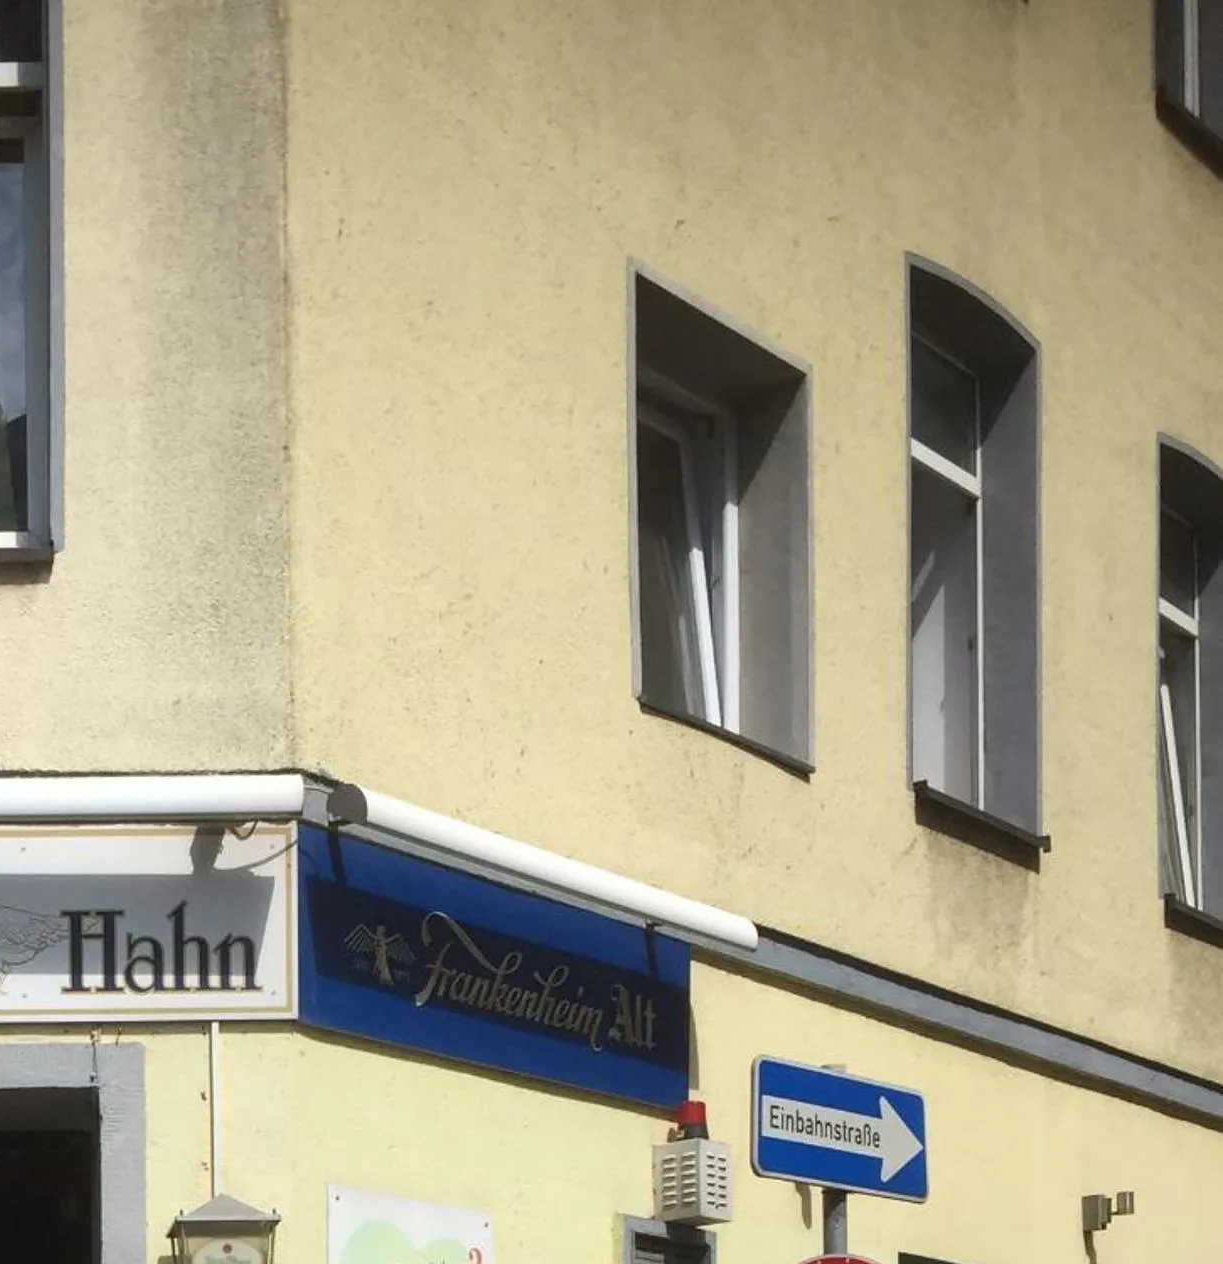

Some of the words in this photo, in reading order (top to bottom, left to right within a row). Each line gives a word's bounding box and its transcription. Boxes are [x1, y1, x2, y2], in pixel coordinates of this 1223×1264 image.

[61, 901, 262, 993] Hahn
[414, 911, 603, 1051] Frankenheim
[608, 983, 656, 1051] Alt
[769, 1104, 881, 1149] Einbahnstraße
